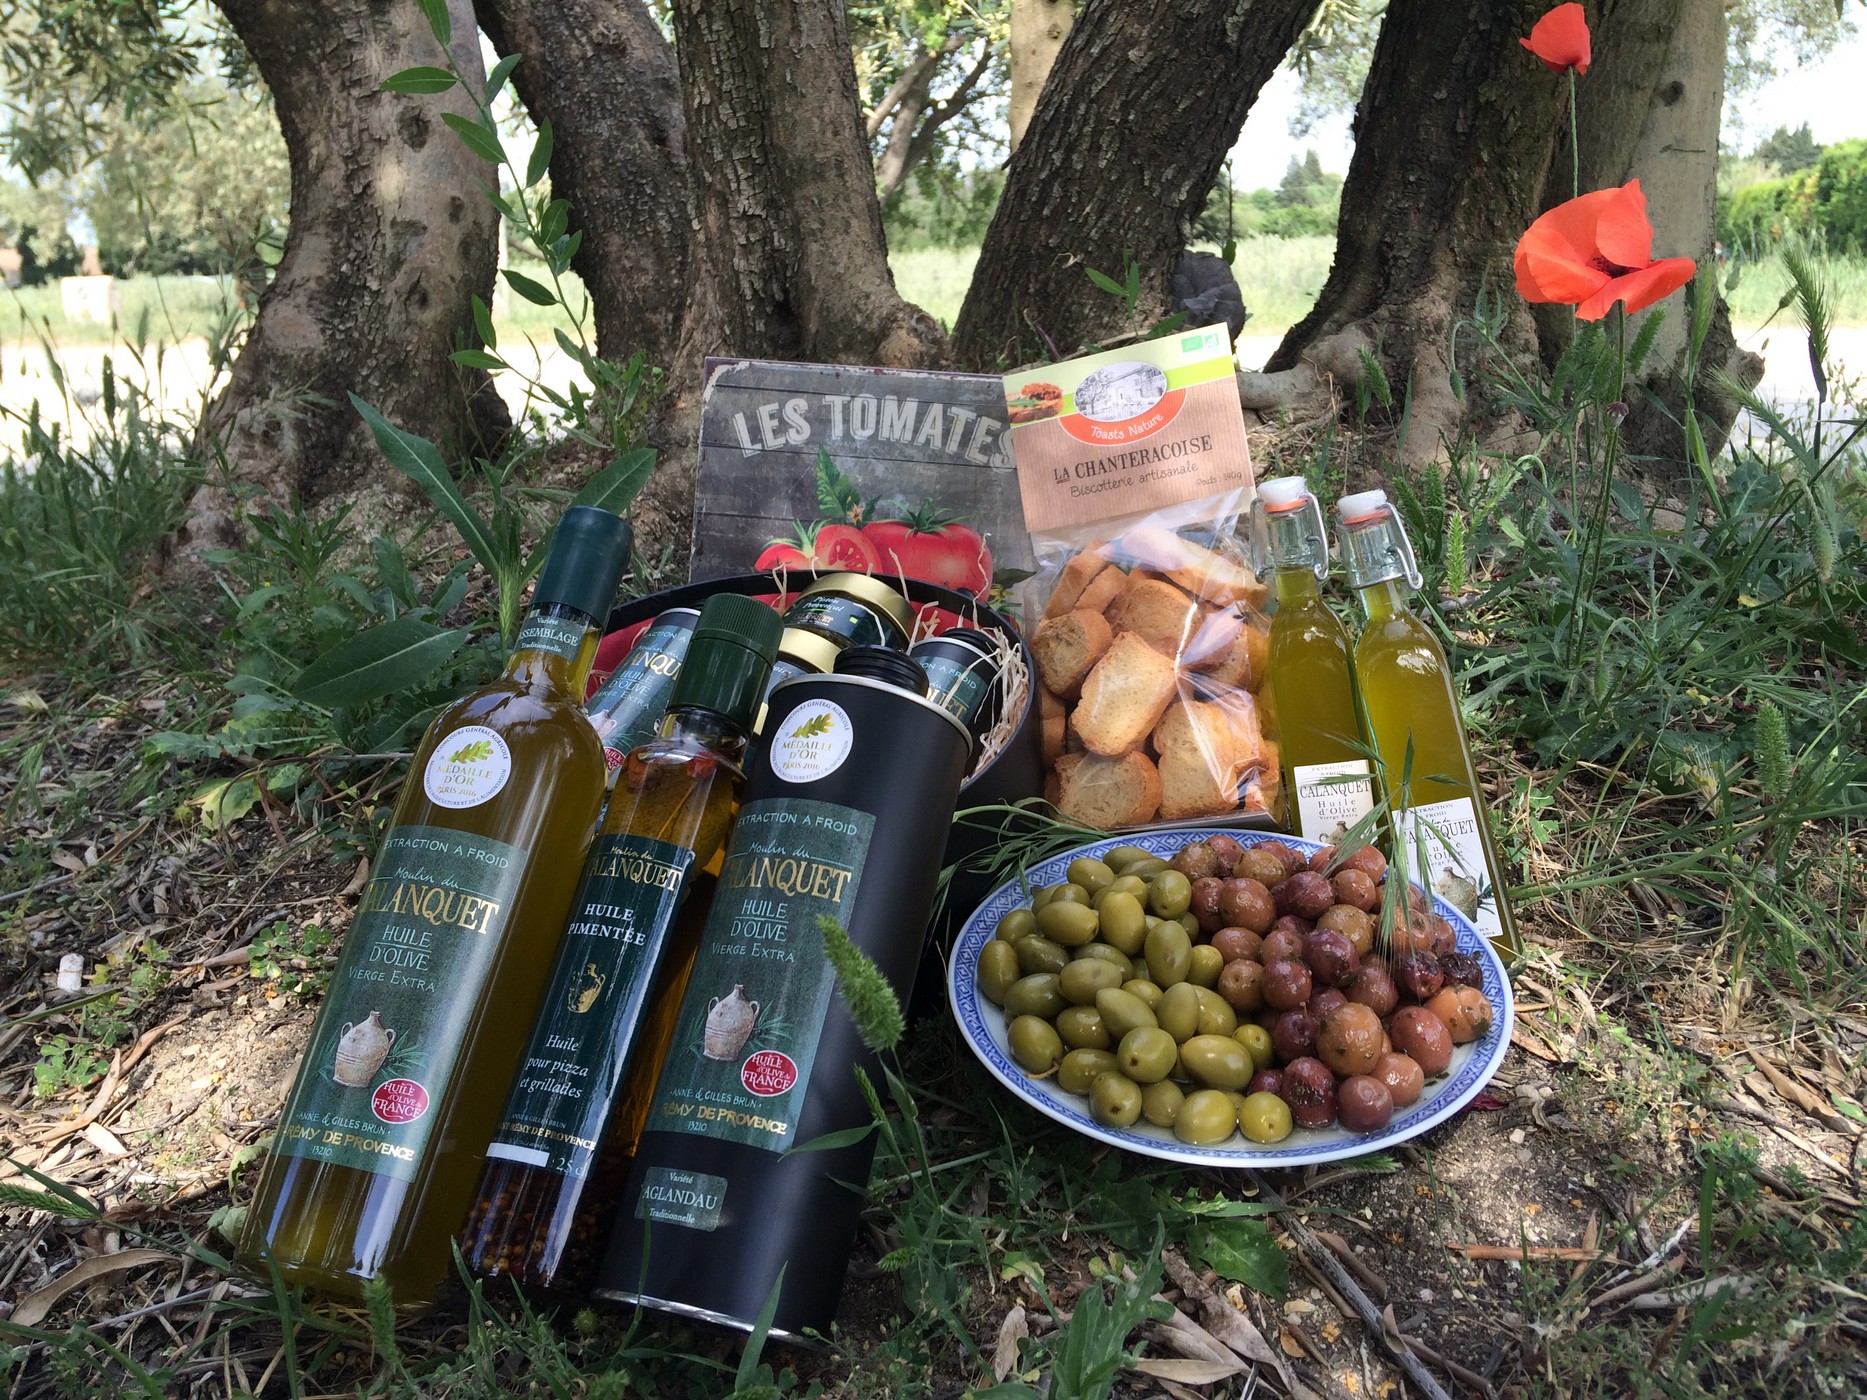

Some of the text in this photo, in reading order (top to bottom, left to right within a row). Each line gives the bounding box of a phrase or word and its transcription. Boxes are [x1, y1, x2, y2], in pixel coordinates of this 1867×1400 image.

[732, 393, 1016, 473] LES TOMATES
[1091, 413, 1164, 440] Toasts Nature
[1054, 435, 1213, 482] LA CHANTERACOISE
[1071, 461, 1199, 498] Biscotterie artisanale
[1224, 472, 1242, 483] 140g
[620, 670, 655, 682] HUILE
[620, 690, 649, 709] EXTRA
[790, 749, 817, 760] D'OR
[444, 775, 474, 786] D'OR
[1300, 779, 1371, 798] CALANQUET
[459, 788, 477, 797] 2016
[1318, 799, 1356, 809] Huile
[1319, 807, 1357, 815] d'Olive
[737, 813, 798, 828] EXTRACTION
[815, 816, 857, 836] FROID
[384, 838, 449, 853] EXTRACTION
[466, 848, 509, 869] FROID
[610, 846, 639, 857] Moulin
[749, 840, 809, 858] Moulin du
[394, 867, 460, 889] Moulin du
[584, 904, 634, 921] HUILE
[741, 899, 788, 919] HUILE
[382, 924, 432, 948] HUILE
[568, 923, 646, 946] PIMENTÉE
[730, 920, 787, 942] D'OLIVE
[369, 946, 430, 971] D'OLIVE
[712, 943, 795, 963] VIERGE EXTRA
[348, 966, 435, 992] VIERGE EXTRA
[546, 1034, 579, 1051] Huile
[525, 1057, 589, 1077] pour pizza
[752, 1055, 782, 1068] HUILE
[384, 1082, 415, 1096] HUILE
[520, 1077, 583, 1098] et grillades
[744, 1071, 790, 1092] FRANCE
[672, 1088, 757, 1108] ANNE & GILLES BRUN
[374, 1098, 421, 1119] FRANCE
[299, 1112, 385, 1135] ANNE & GILLES BRUN
[688, 1121, 707, 1131] 13210
[697, 1105, 716, 1120] DE
[717, 1108, 787, 1135] PROVENCE
[322, 1130, 342, 1145] DE
[343, 1134, 414, 1161] PROVENCE
[531, 1127, 544, 1138] DE
[544, 1128, 596, 1150] PROVENCE
[312, 1146, 333, 1157] 13210
[556, 1157, 573, 1174] 25
[670, 1172, 694, 1184] Variété
[642, 1186, 718, 1210] AGLANDAU
[649, 1208, 695, 1224] Traditionnelle
